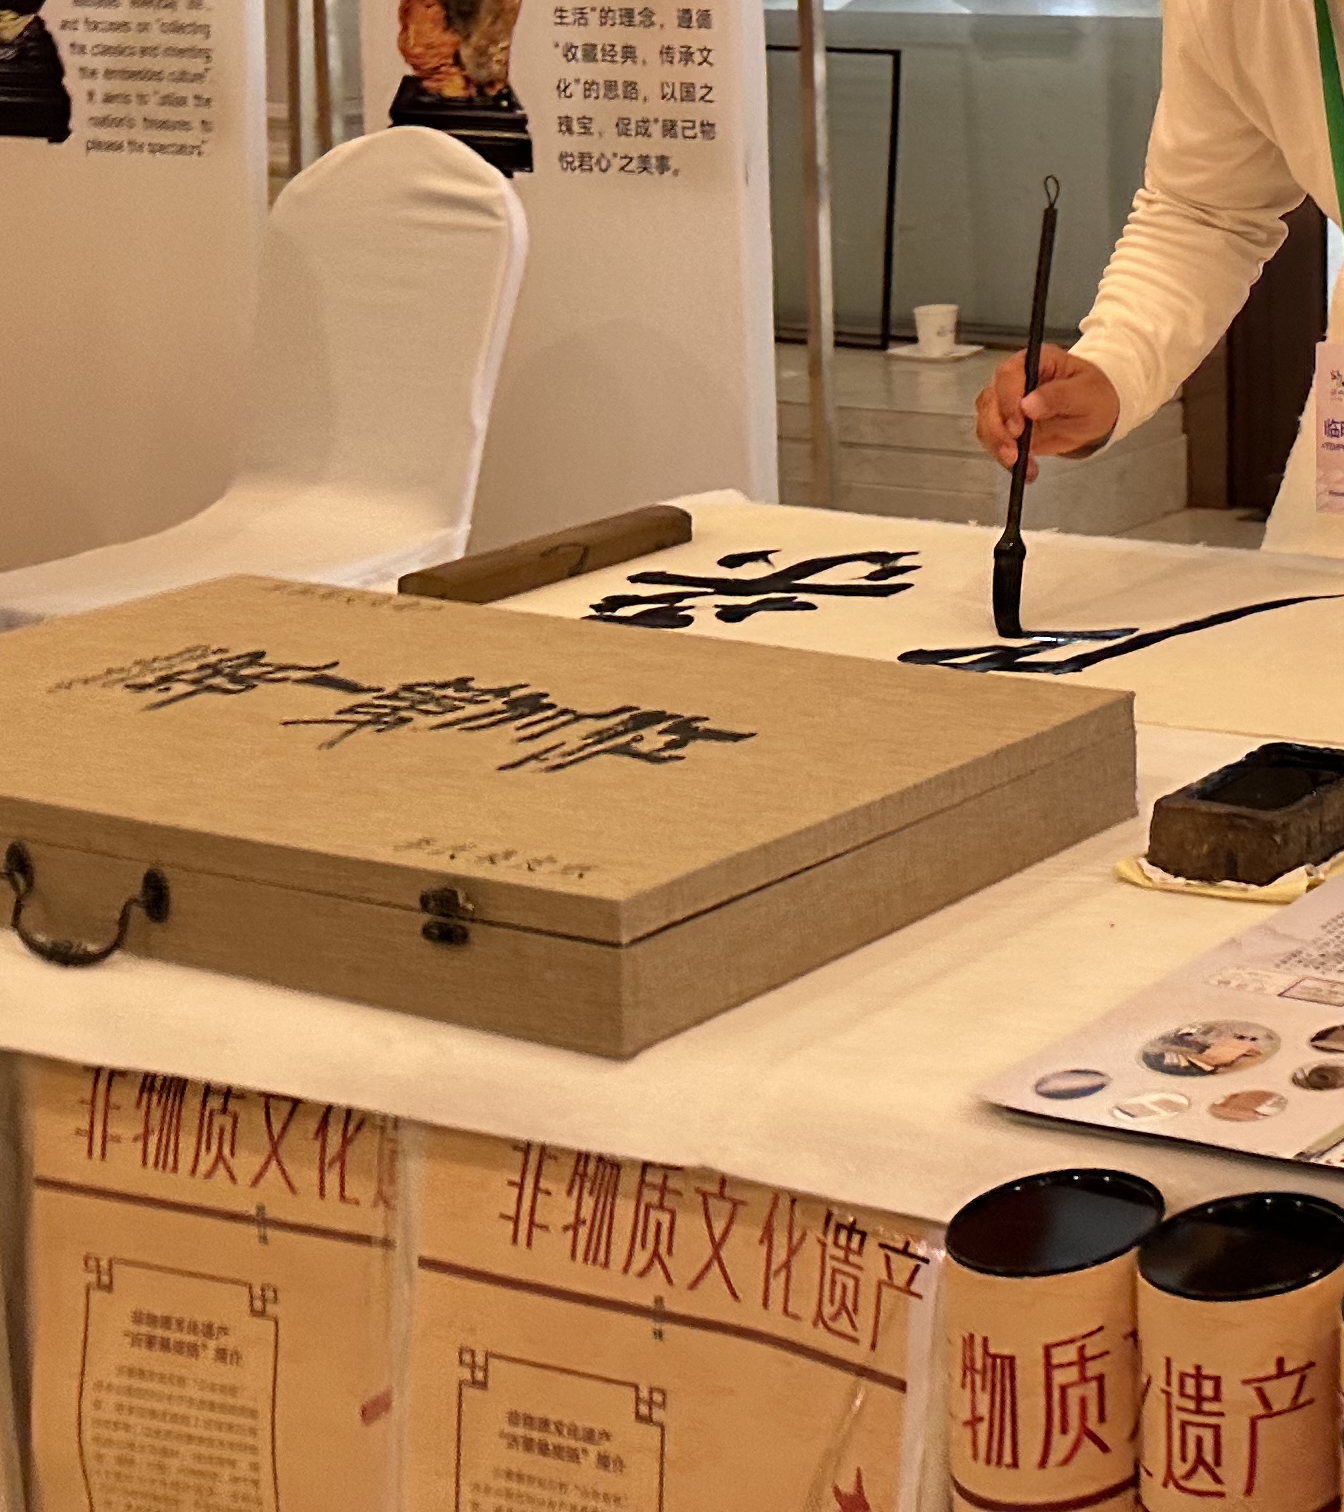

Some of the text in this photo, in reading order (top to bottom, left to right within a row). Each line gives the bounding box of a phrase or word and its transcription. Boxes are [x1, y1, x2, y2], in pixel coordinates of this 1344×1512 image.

[500, 1140, 933, 1353] 非物质文化遗产
